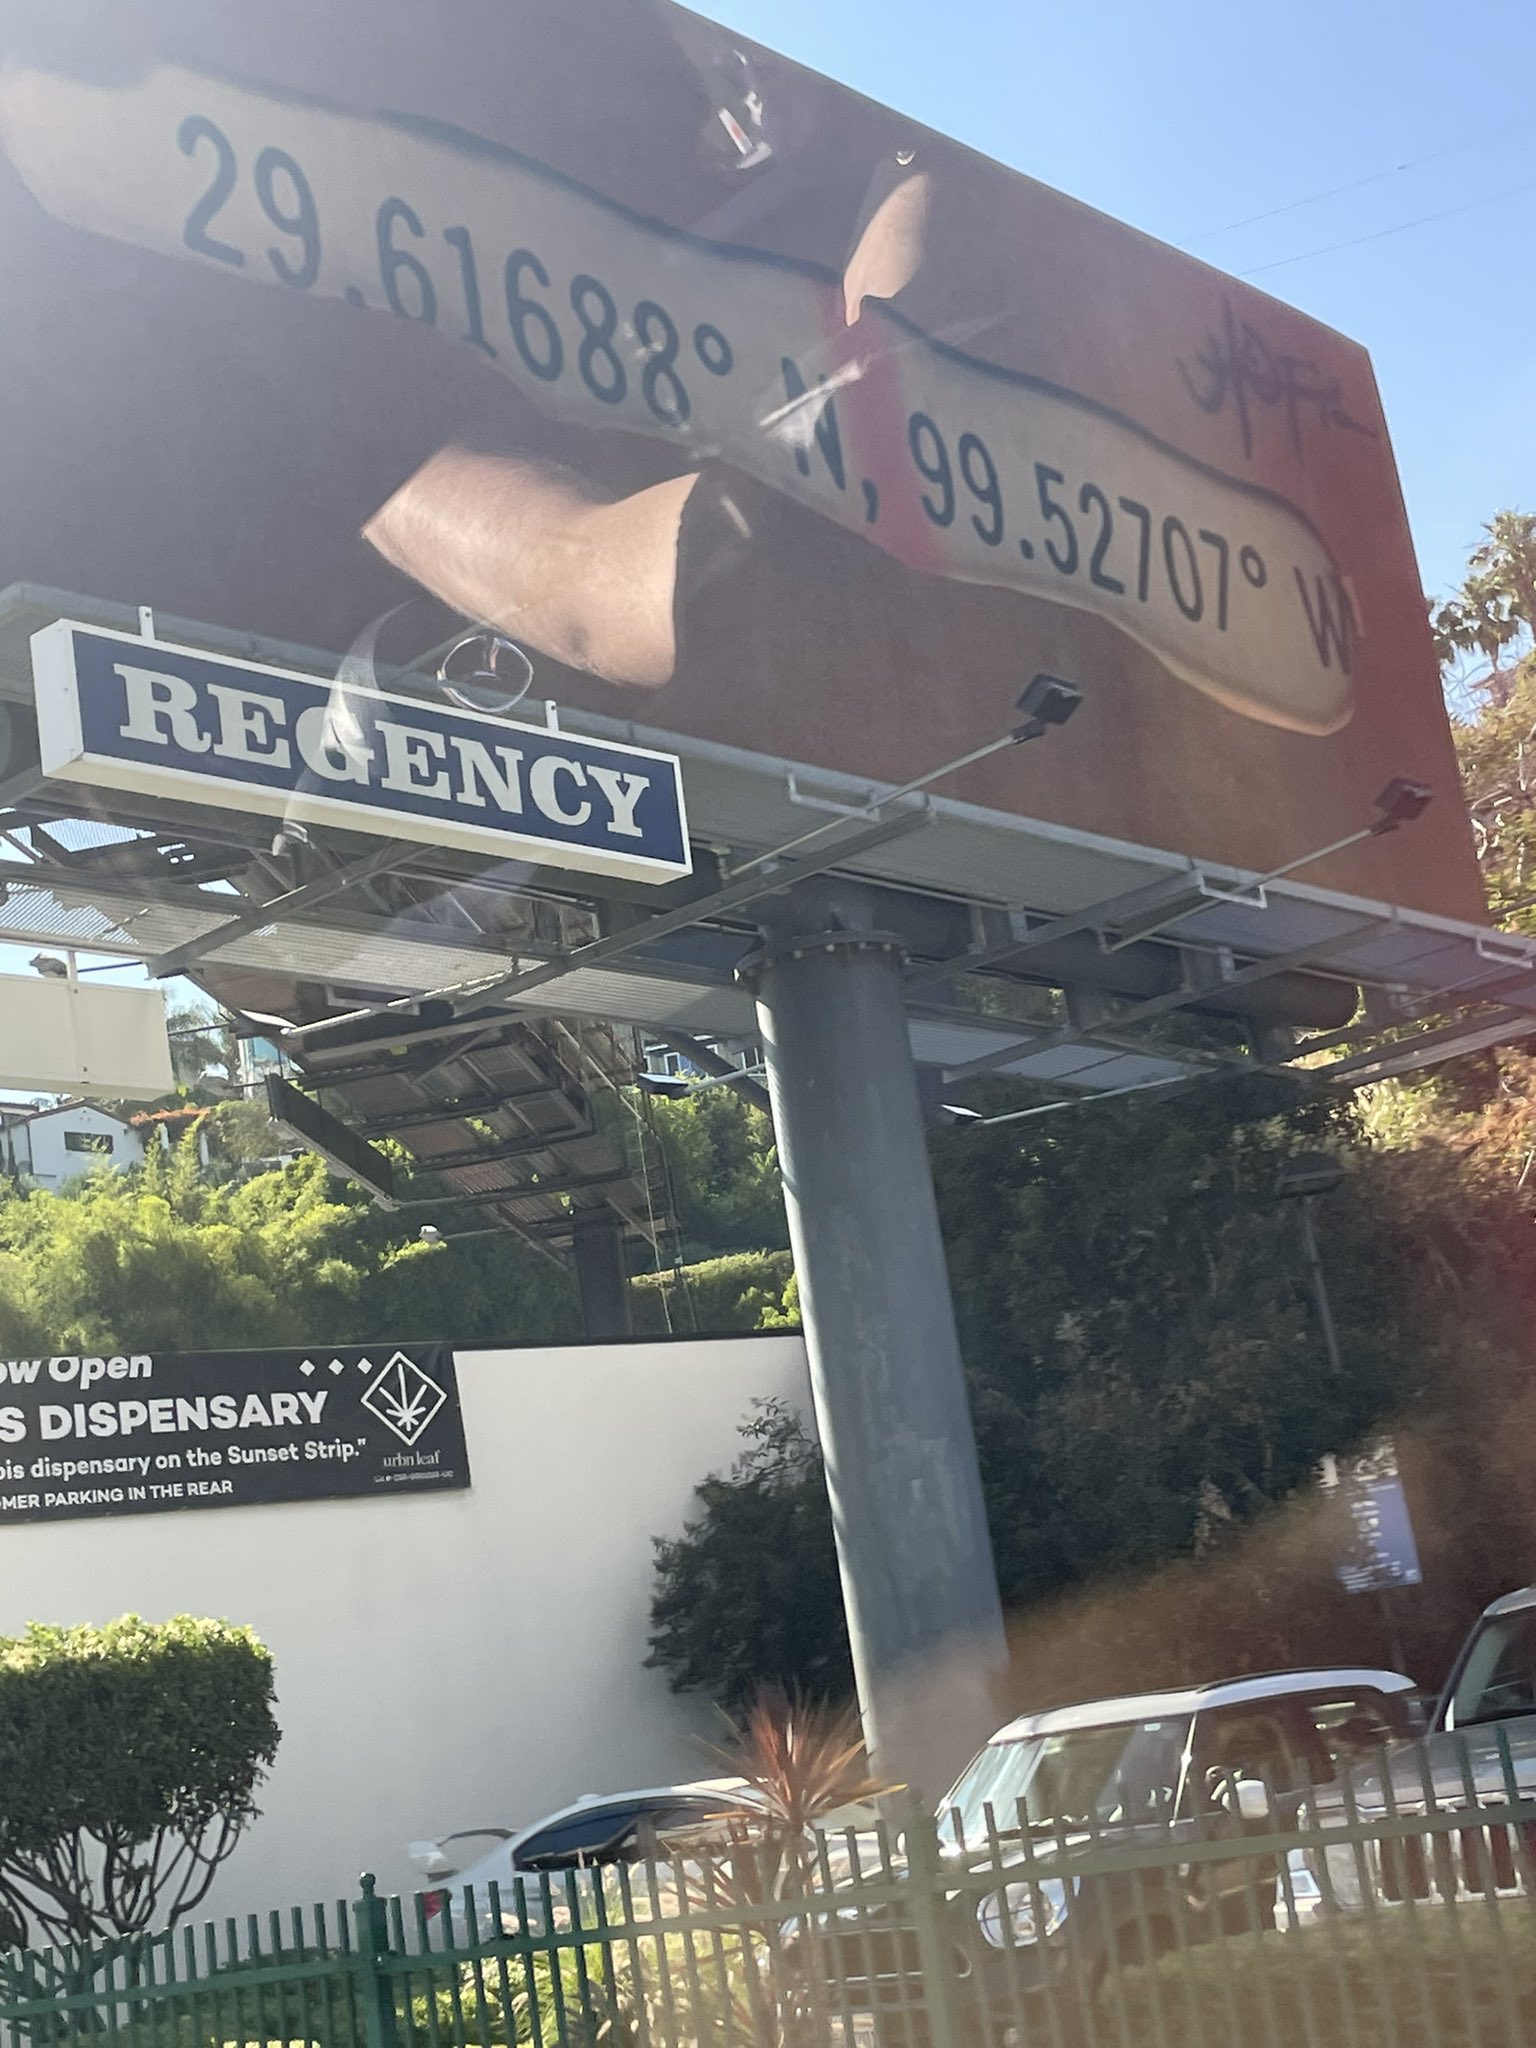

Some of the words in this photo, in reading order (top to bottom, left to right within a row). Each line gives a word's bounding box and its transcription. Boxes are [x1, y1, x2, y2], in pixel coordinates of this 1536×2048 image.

[1294, 566, 1366, 676] W
[113, 662, 651, 839] REGENCY
[49, 1355, 153, 1390] Open
[39, 1390, 328, 1441] DISPENSARY
[30, 1456, 151, 1482] dispensary
[155, 1453, 181, 1469] on
[186, 1447, 222, 1468] the
[227, 1443, 300, 1465] Sunset
[304, 1438, 367, 1463] Strip."
[44, 1488, 124, 1507] PARKING
[128, 1485, 146, 1501] IN
[150, 1483, 184, 1499] THE
[187, 1480, 234, 1496] REAR
